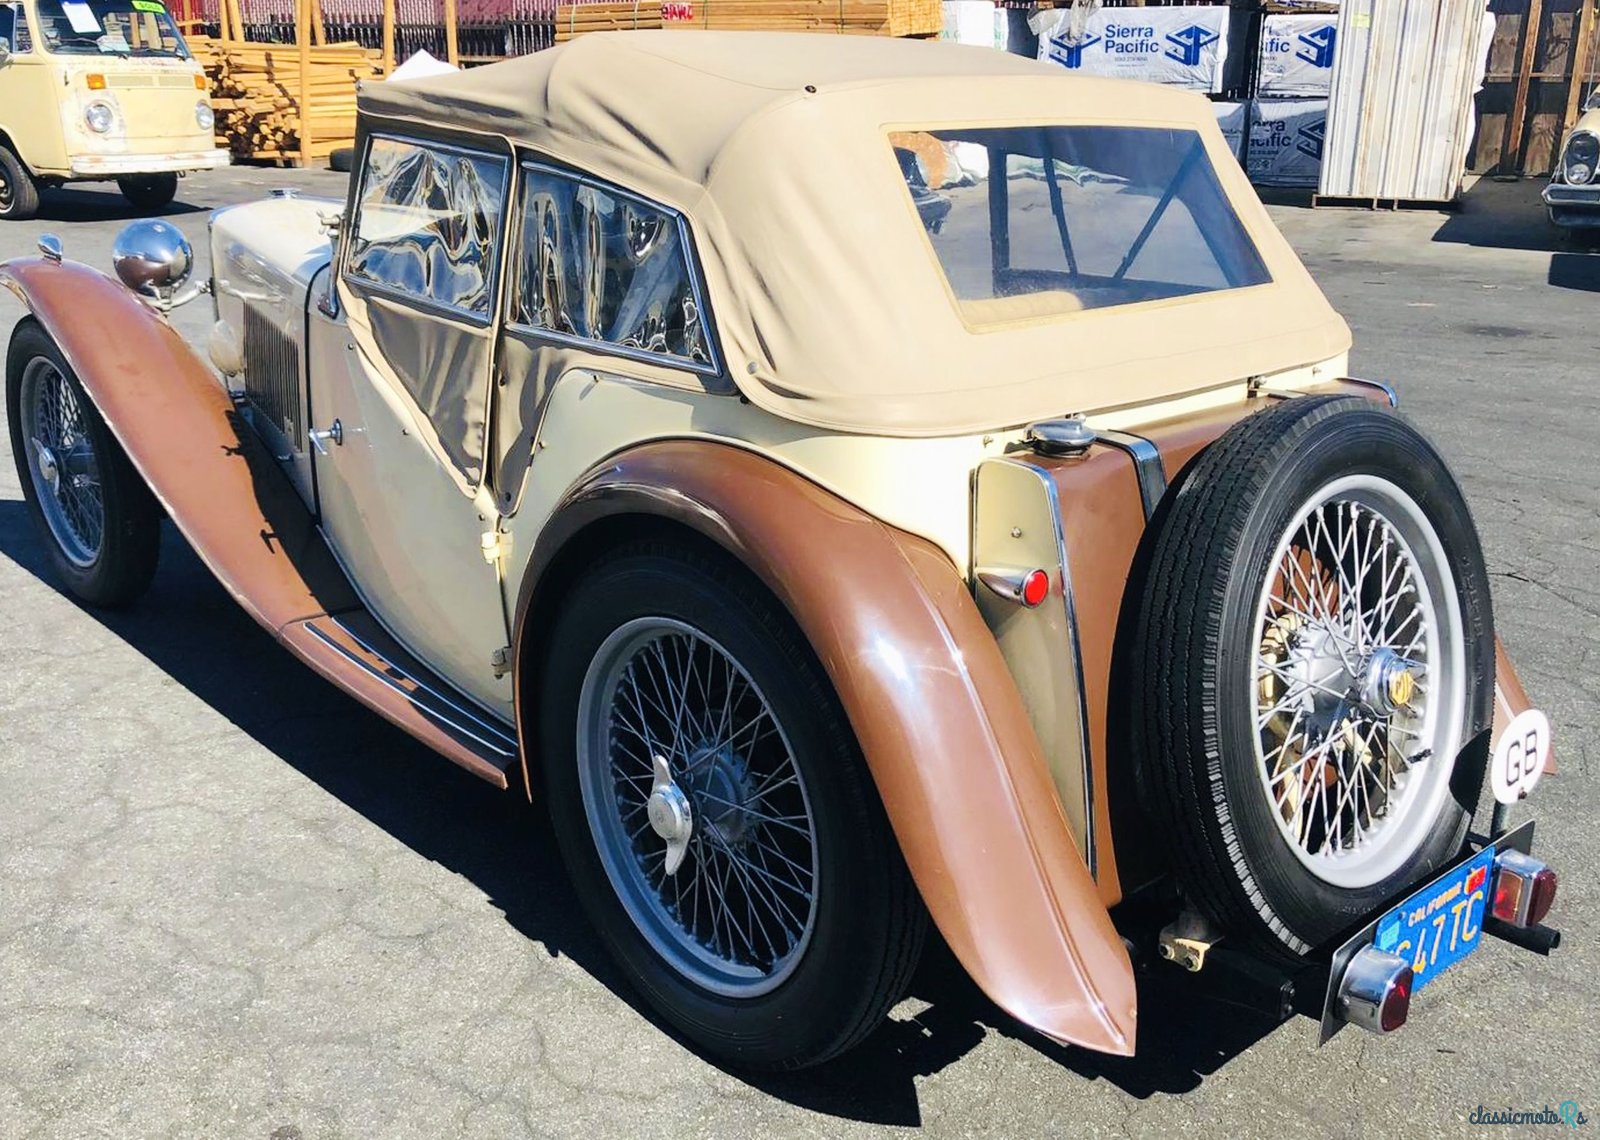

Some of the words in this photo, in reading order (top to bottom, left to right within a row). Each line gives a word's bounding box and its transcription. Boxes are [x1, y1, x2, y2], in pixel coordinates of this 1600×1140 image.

[1105, 24, 1154, 38] Sierra
[1105, 39, 1159, 53] Pacific
[1506, 729, 1538, 787] GB
